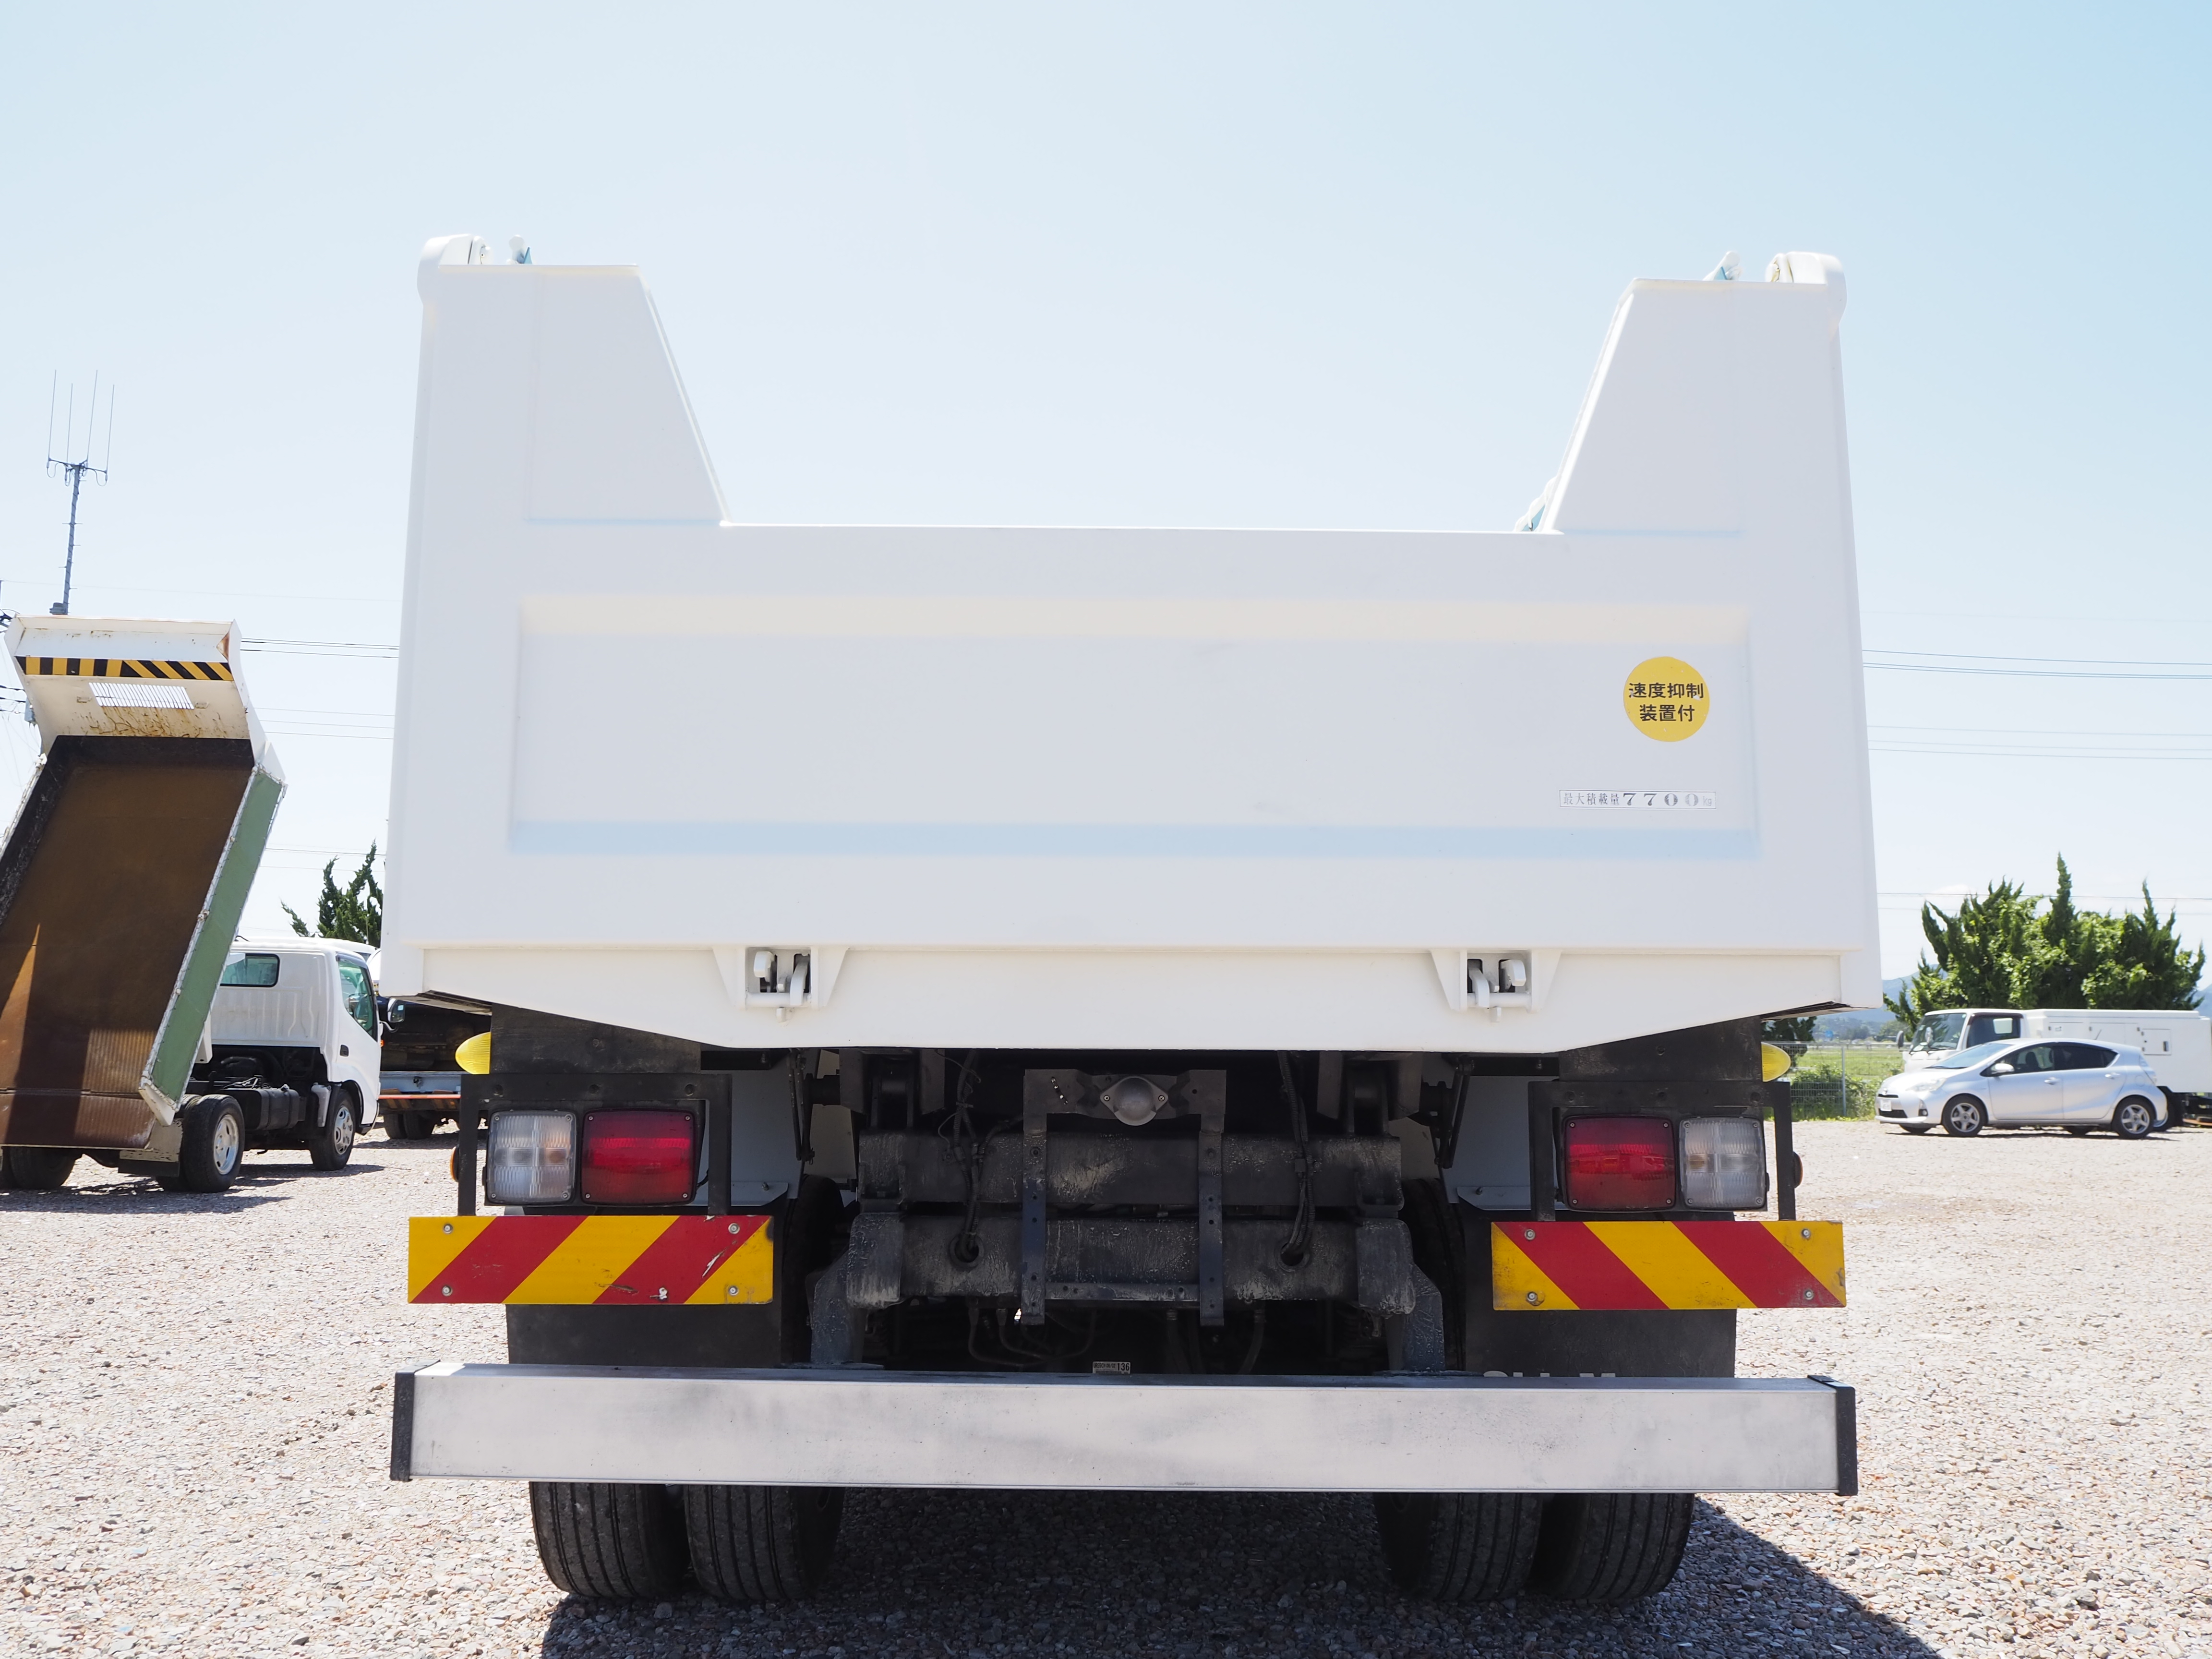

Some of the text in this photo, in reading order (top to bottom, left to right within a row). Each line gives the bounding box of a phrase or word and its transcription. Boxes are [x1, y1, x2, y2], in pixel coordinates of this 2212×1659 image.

[1629, 682, 1704, 699] 速度抑制
[1639, 704, 1695, 722] 装置付
[1118, 1362, 1130, 1371] 136
